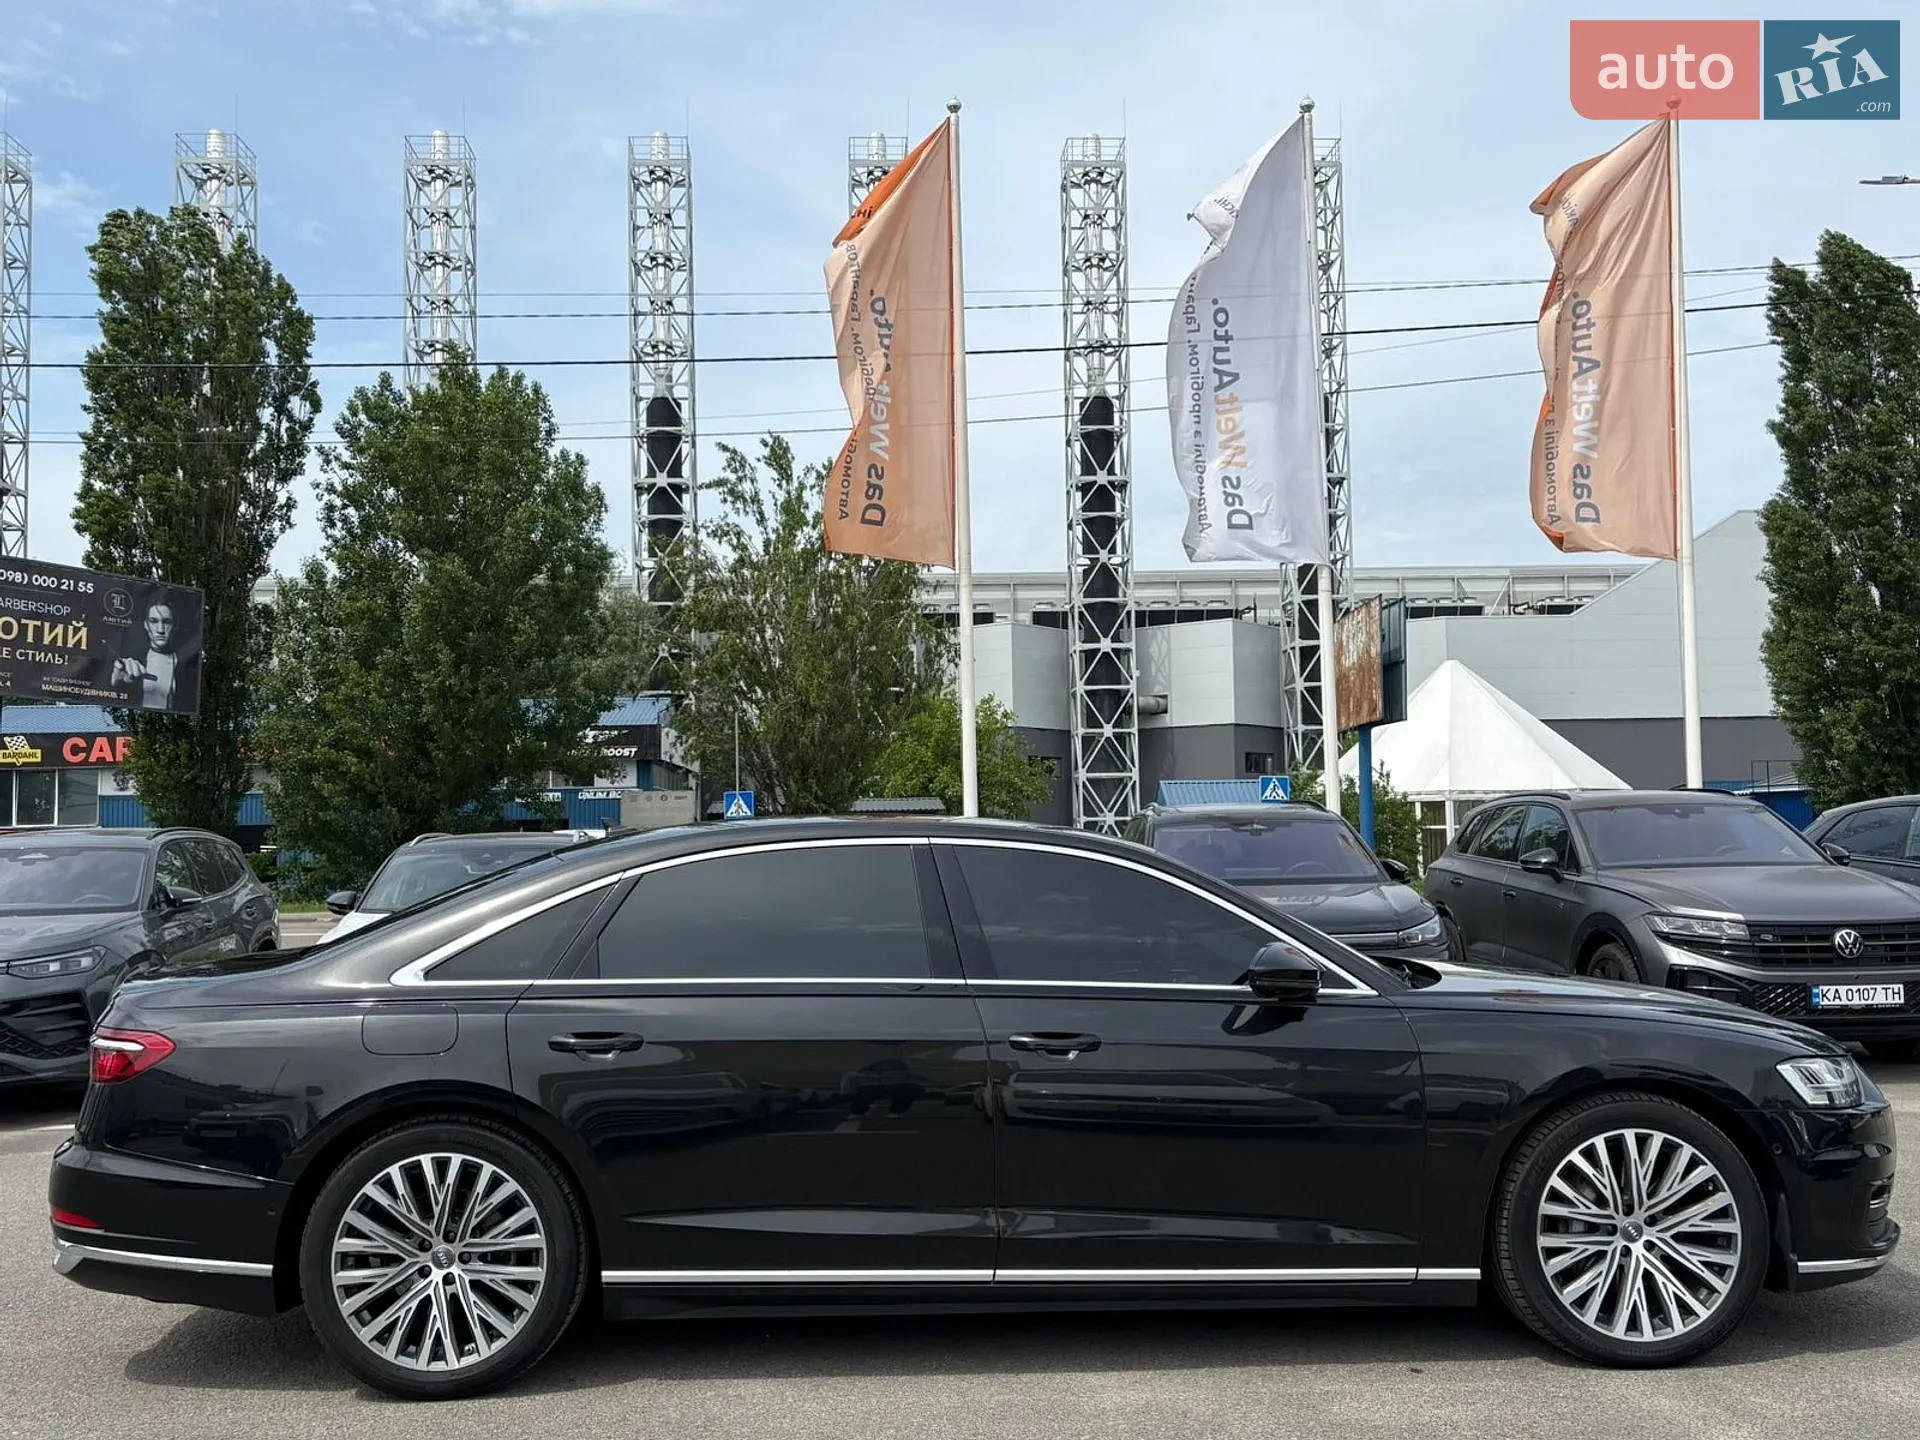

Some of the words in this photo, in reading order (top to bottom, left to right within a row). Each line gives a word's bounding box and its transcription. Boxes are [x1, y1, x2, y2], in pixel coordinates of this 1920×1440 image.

[32, 574, 58, 588] 000
[60, 579, 75, 591] 21
[77, 581, 94, 594] 55
[0, 616, 88, 650] ОТИЙ
[16, 649, 69, 665] СТИЛЬ!
[602, 747, 638, 758] OOST
[1821, 987, 1841, 1002] KA
[1845, 986, 1878, 1002] 0107
[1882, 986, 1901, 1001] TH
